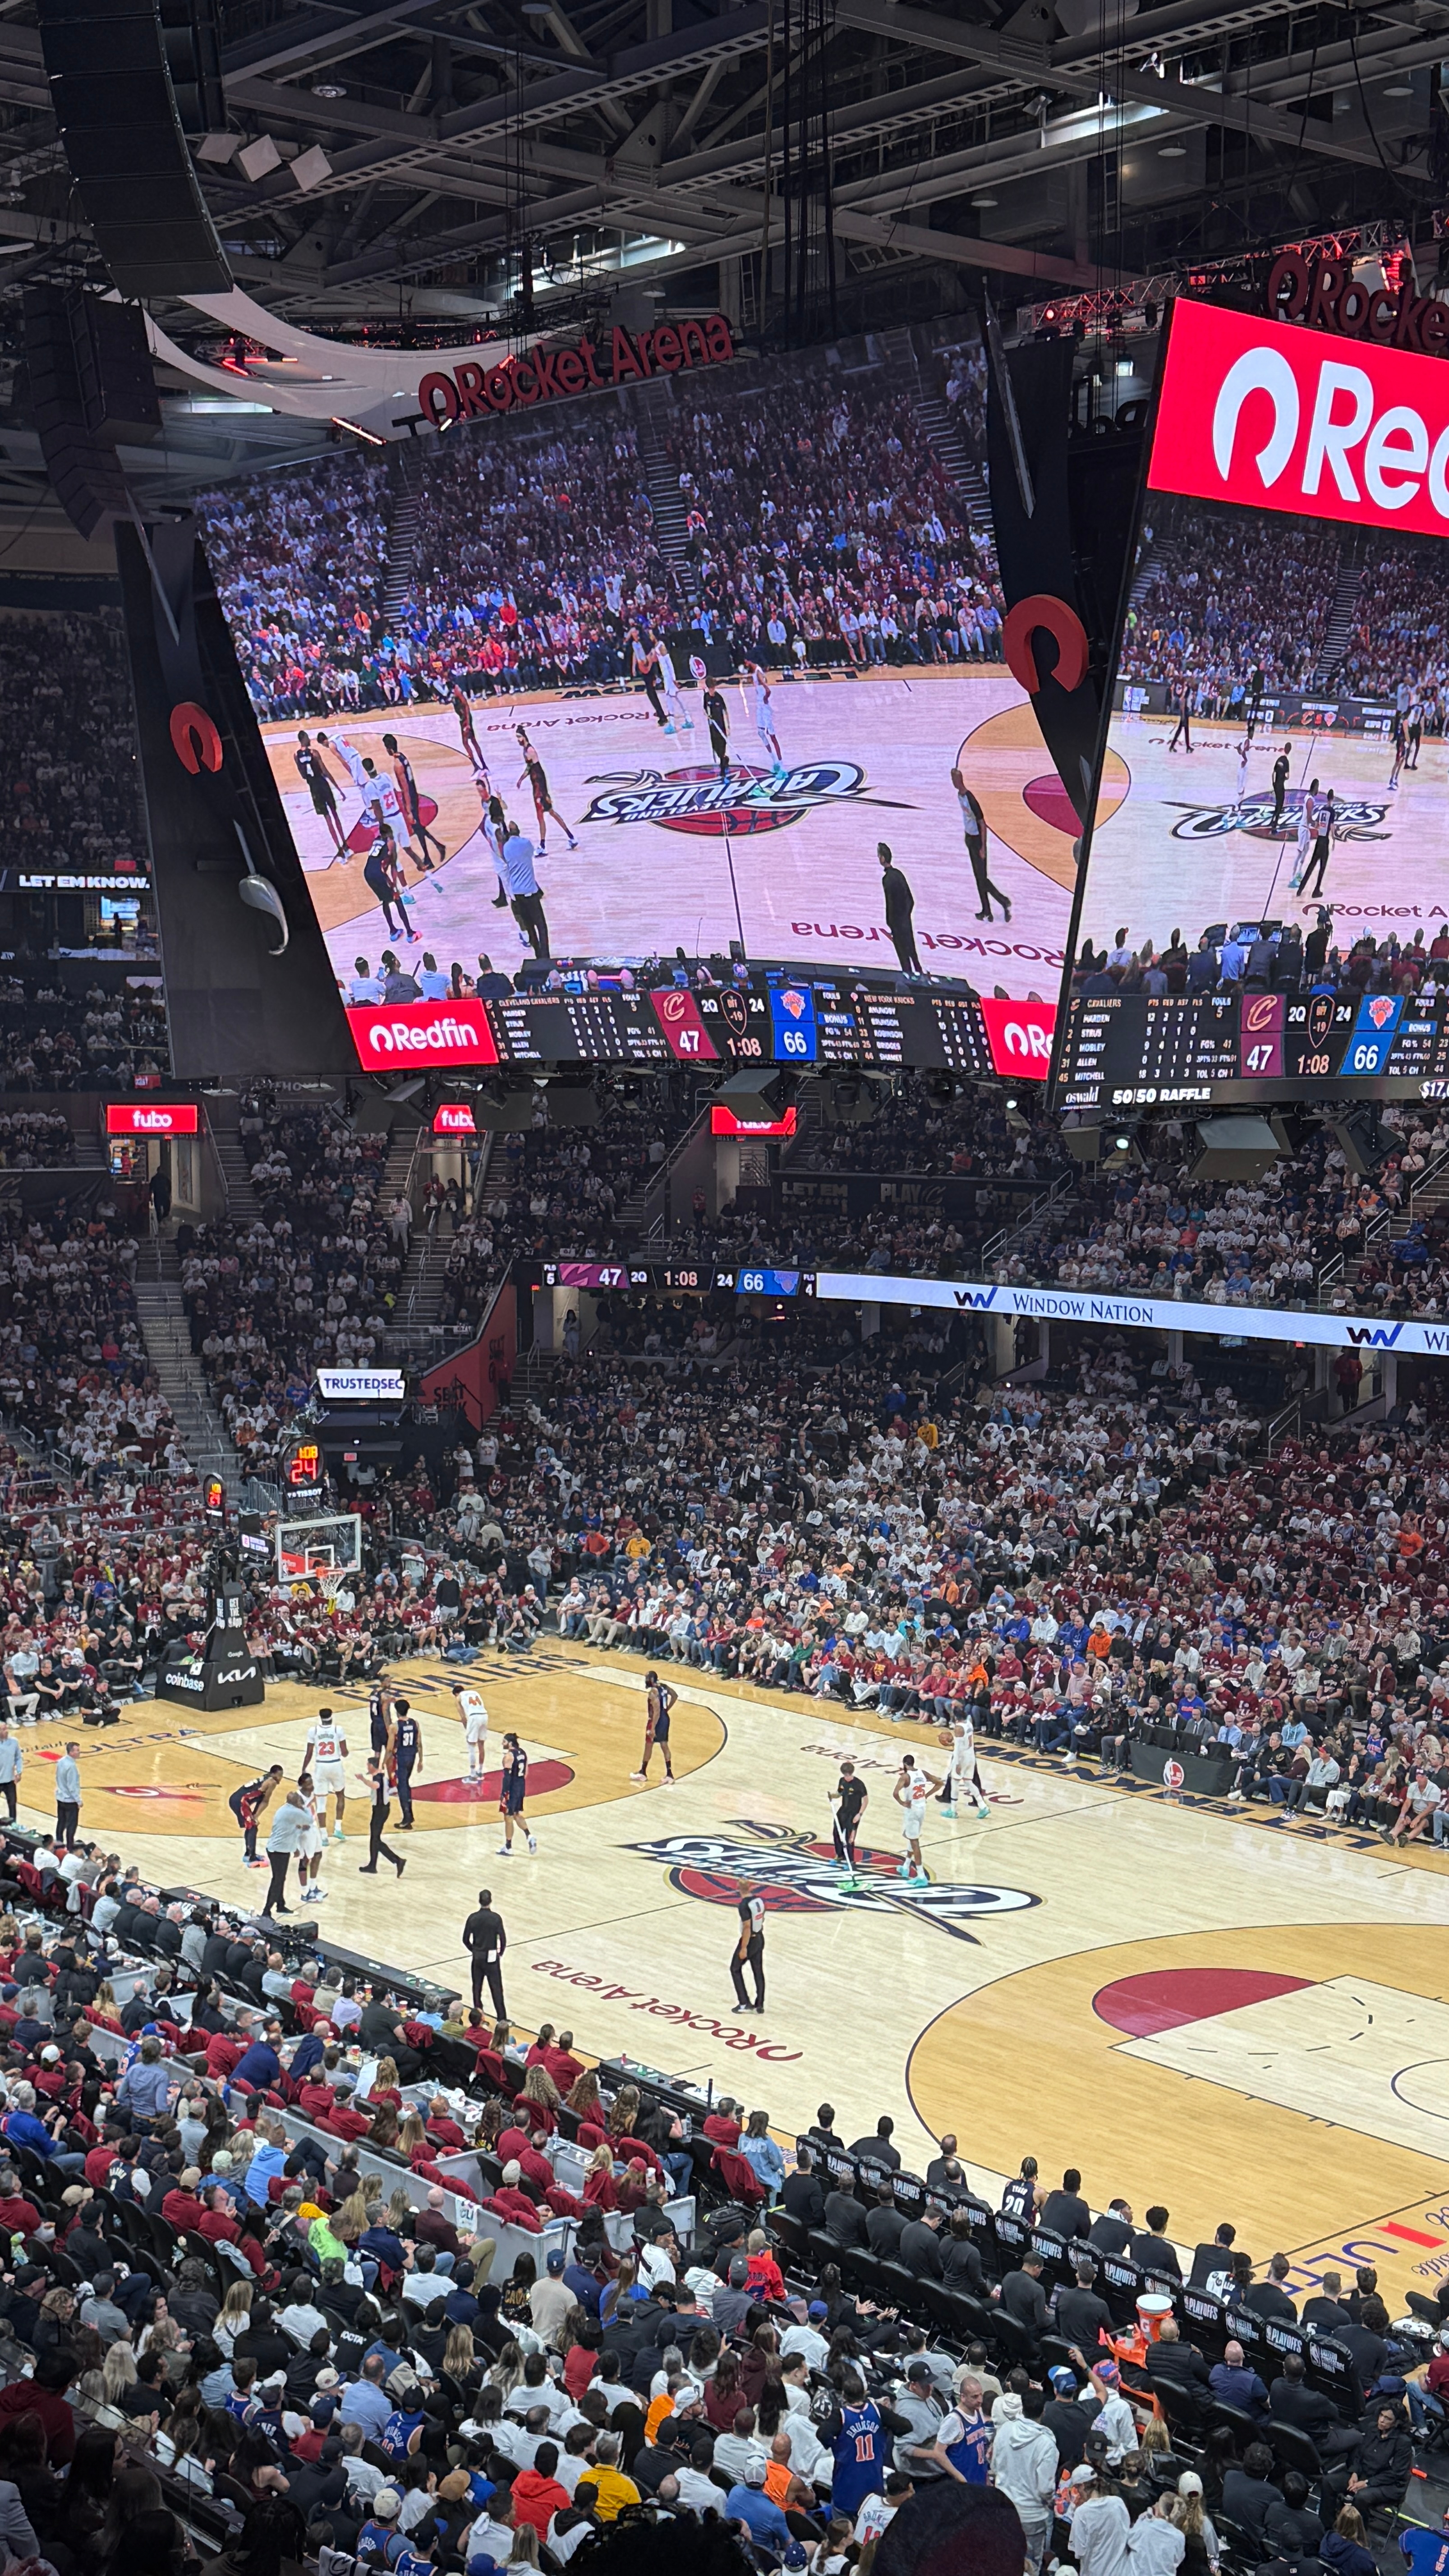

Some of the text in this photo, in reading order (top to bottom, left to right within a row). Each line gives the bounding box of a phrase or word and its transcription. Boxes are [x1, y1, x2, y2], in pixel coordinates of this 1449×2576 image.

[453, 315, 734, 418] Rocket Arena
[565, 711, 650, 725] Rocket
[19, 875, 150, 889] LET EM KNOW.
[1329, 903, 1423, 919] Rocket
[701, 999, 718, 1013] 2Q
[749, 998, 765, 1012] 24
[1288, 1006, 1306, 1022] 2Q
[1335, 1006, 1352, 1022] 24
[392, 1017, 479, 1051] Redfin
[680, 1030, 699, 1052] 47
[1067, 1029, 1073, 1039] 2
[1081, 1028, 1102, 1038] STRUS
[727, 1038, 762, 1057] 1:08
[783, 1031, 807, 1053] 66
[1065, 1044, 1071, 1053] 4
[1061, 1058, 1070, 1068] 31
[1076, 1058, 1098, 1067] ALLEN
[1247, 1045, 1273, 1071] 47
[1297, 1054, 1330, 1074] 1:08
[1354, 1044, 1379, 1070] 66
[1058, 1072, 1068, 1082] 45
[1075, 1072, 1105, 1081] MITCHELL
[1066, 1087, 1099, 1104] oswald
[1159, 1088, 1211, 1101] RAFFLE
[133, 1111, 172, 1127] fubo
[782, 1181, 848, 1197] LET EM
[881, 1183, 921, 1203] PLAY
[547, 1274, 555, 1285] 5
[598, 1269, 622, 1286] 47
[631, 1271, 647, 1283] 2Q
[664, 1271, 698, 1287] 1:08
[718, 1274, 734, 1287] 24
[744, 1273, 764, 1291] 66
[805, 1283, 813, 1297] 4
[1090, 1300, 1154, 1324] NATION
[324, 1378, 403, 1390] TRUSTEDSEC
[291, 1459, 317, 1483] 24
[166, 1672, 205, 1692] coinbase
[318, 1741, 335, 1756] 23
[912, 1785, 925, 1800] 25
[1243, 1814, 1385, 1849] LET
[531, 1960, 772, 2051] Rocket Arena
[1004, 2195, 1025, 2215] 20
[1036, 2236, 1063, 2259] PLAYOFFS
[1109, 2263, 1138, 2287] PLAYOFFS
[1188, 2298, 1219, 2321] PLAYOFFS
[1141, 2318, 1151, 2333] G
[1271, 2327, 1303, 2354] PLAYOFFS
[855, 2433, 875, 2462] 11
